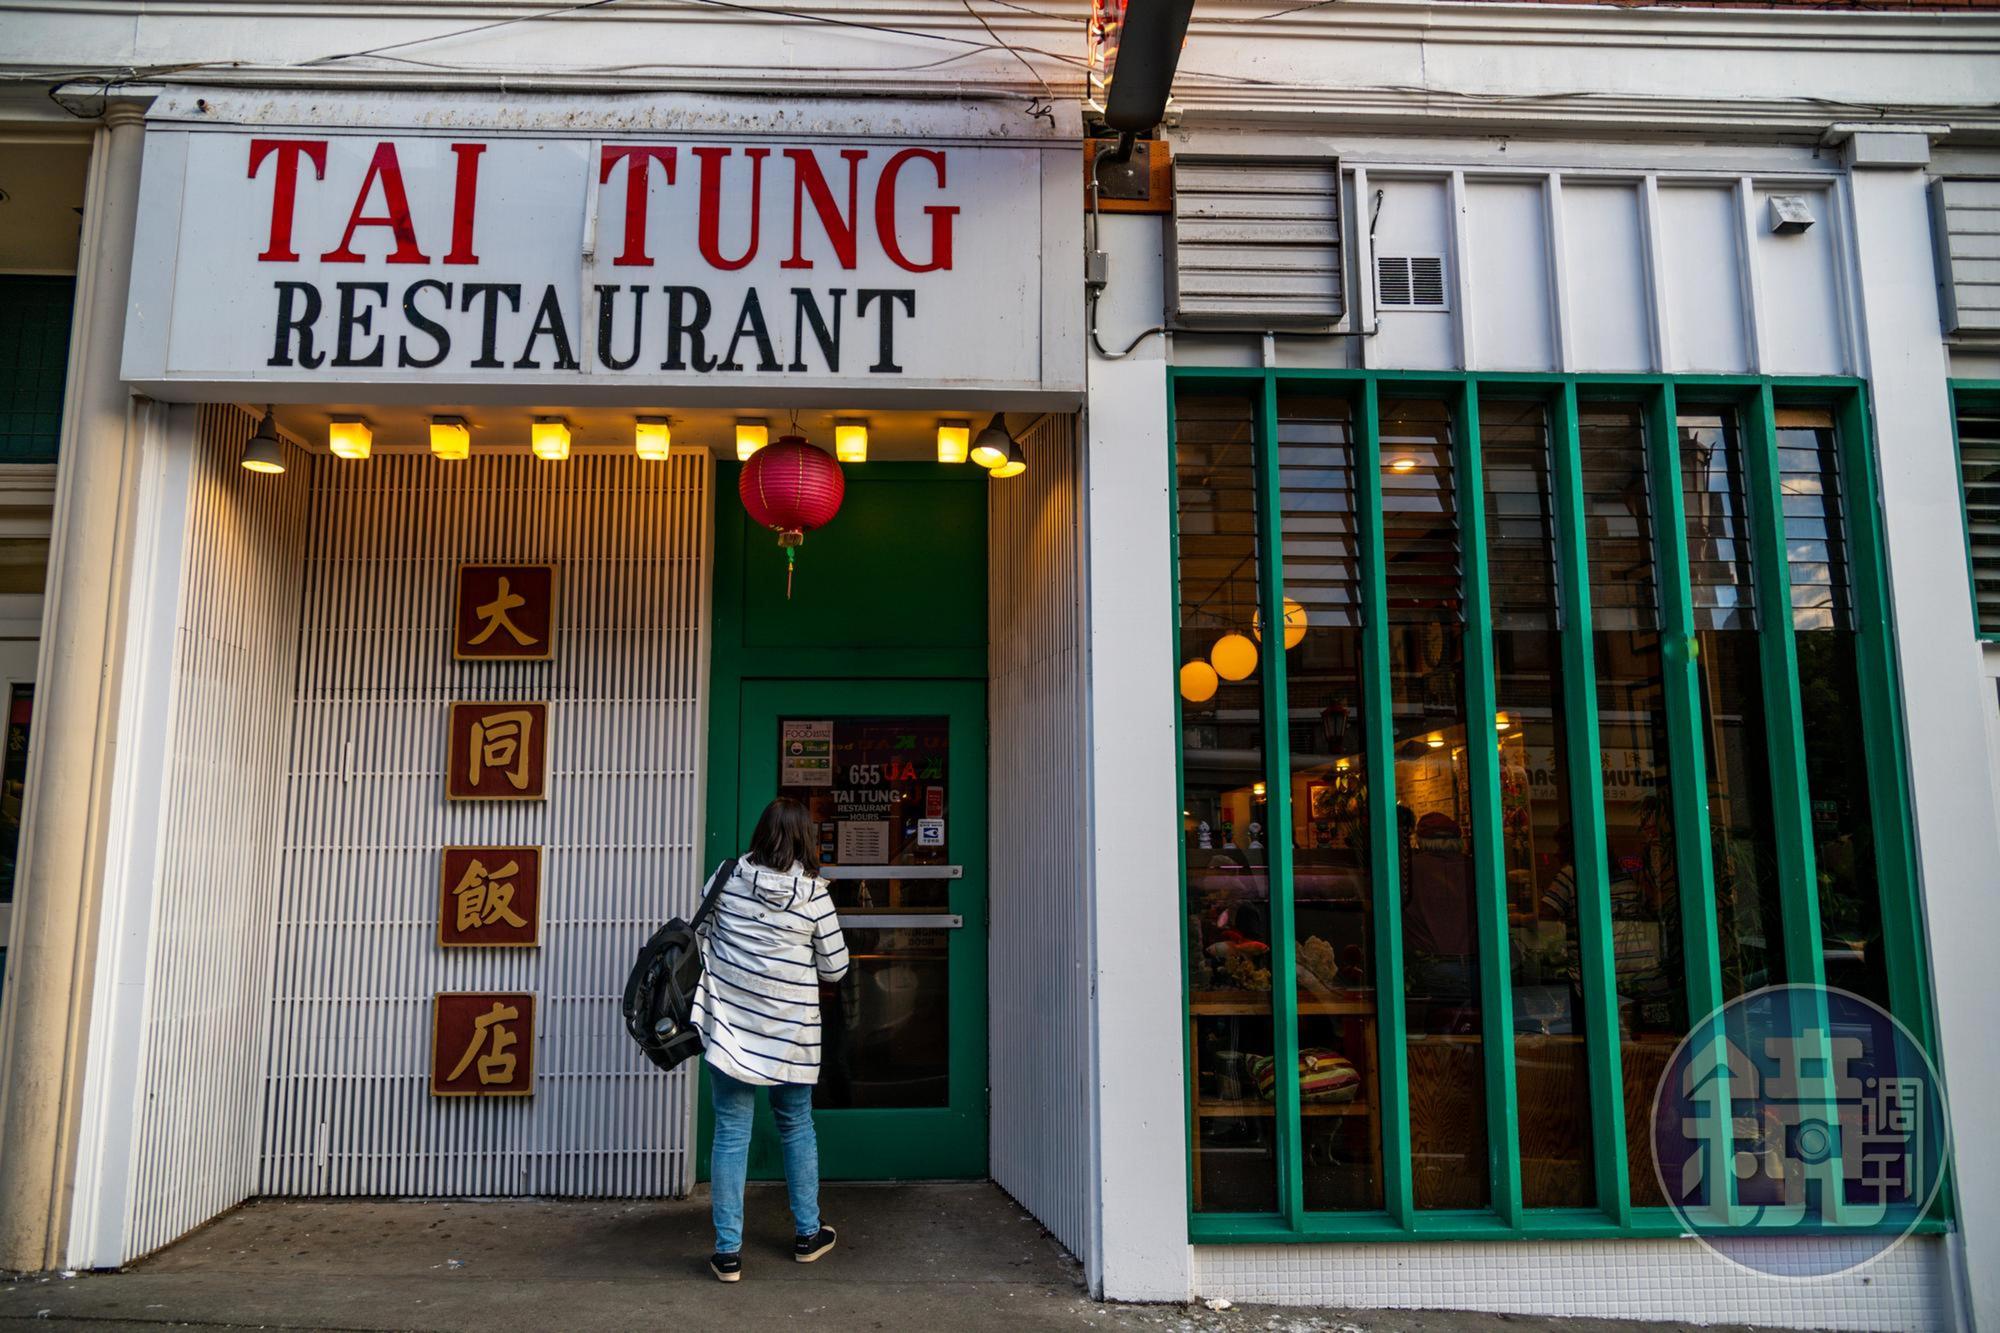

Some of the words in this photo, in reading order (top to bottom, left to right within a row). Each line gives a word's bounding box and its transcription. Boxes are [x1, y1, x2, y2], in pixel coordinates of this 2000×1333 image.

[247, 139, 487, 265] TAI
[600, 145, 961, 273] TUNG
[267, 279, 916, 373] RESTAURANT
[786, 730, 813, 738] FOOD
[849, 764, 881, 785] 655
[830, 790, 855, 803] TAI
[858, 789, 900, 803] TUNG
[838, 804, 892, 812] RESTAURANT
[849, 813, 879, 821] HOURS
[446, 577, 538, 1083] 大同飯店
